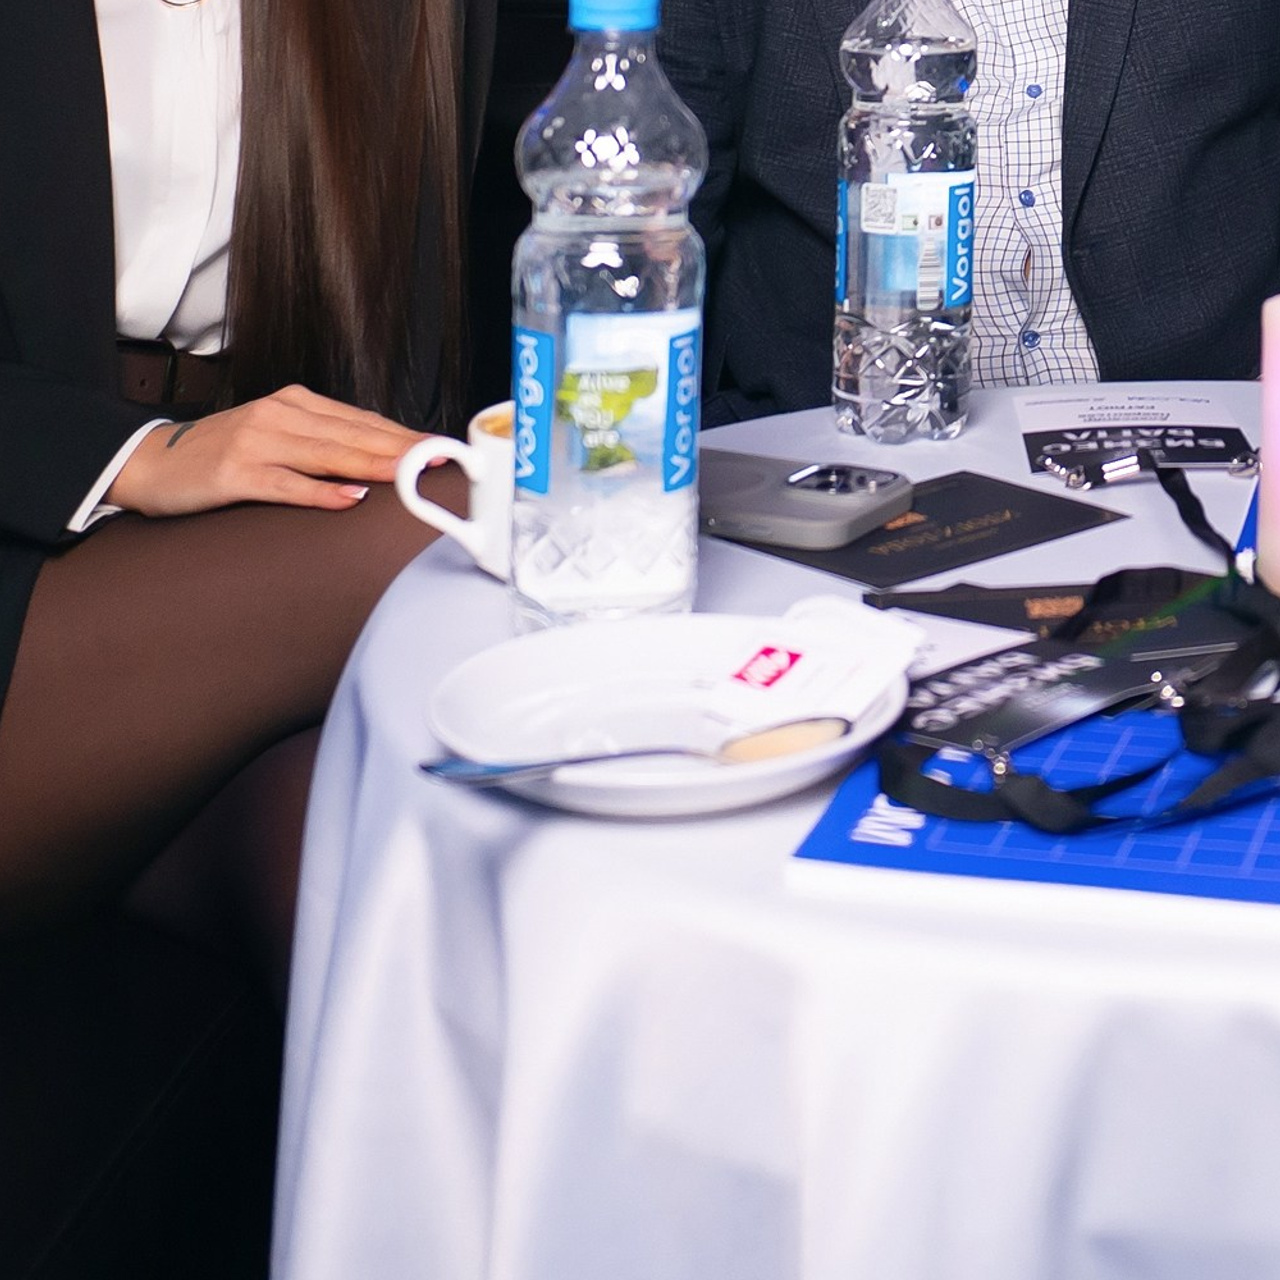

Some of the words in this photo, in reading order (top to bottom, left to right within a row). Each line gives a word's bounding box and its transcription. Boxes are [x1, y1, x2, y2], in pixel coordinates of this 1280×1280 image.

[951, 187, 972, 301] Vorgol
[516, 334, 544, 478] Vorgol
[669, 336, 697, 485] Vorgol
